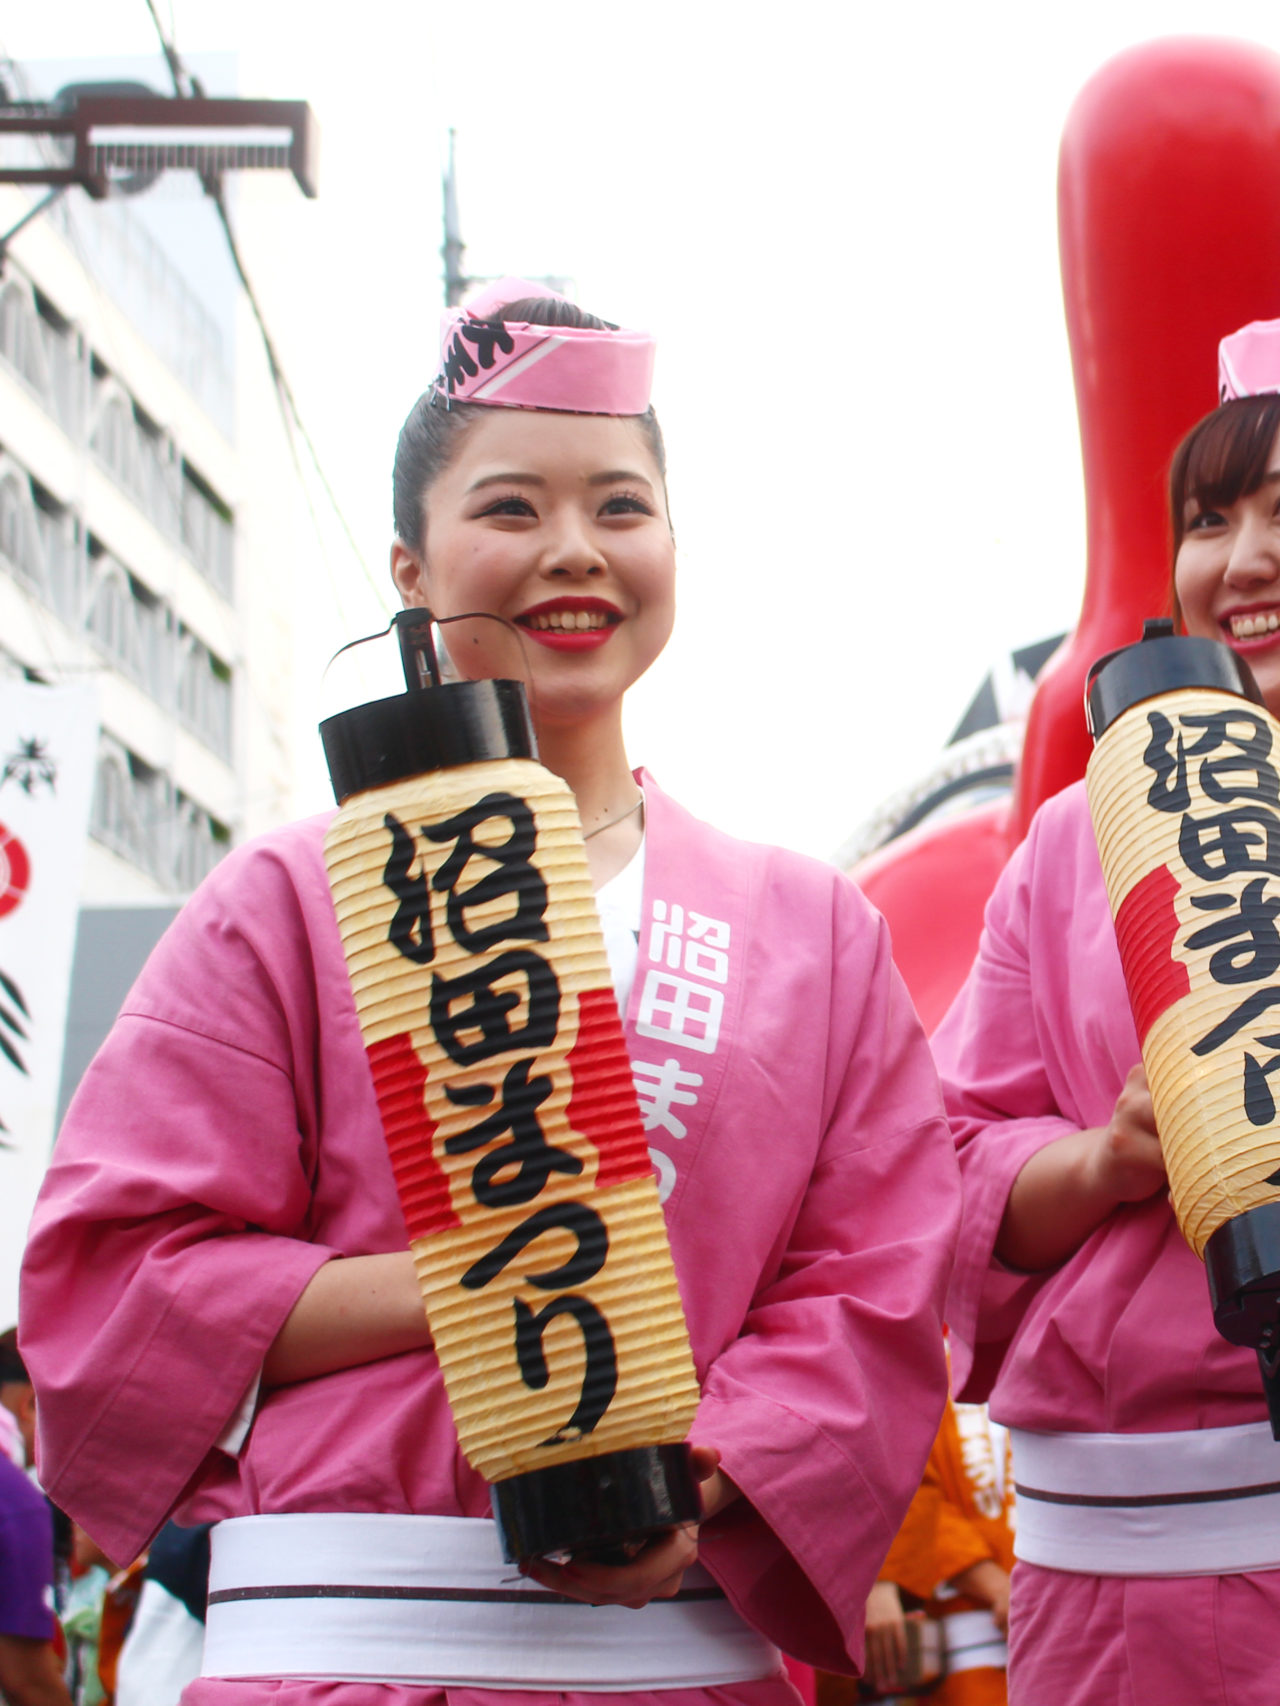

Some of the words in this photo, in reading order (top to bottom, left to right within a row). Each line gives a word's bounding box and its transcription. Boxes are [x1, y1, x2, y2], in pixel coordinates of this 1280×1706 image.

[383, 791, 619, 1448] 沼田まつり
